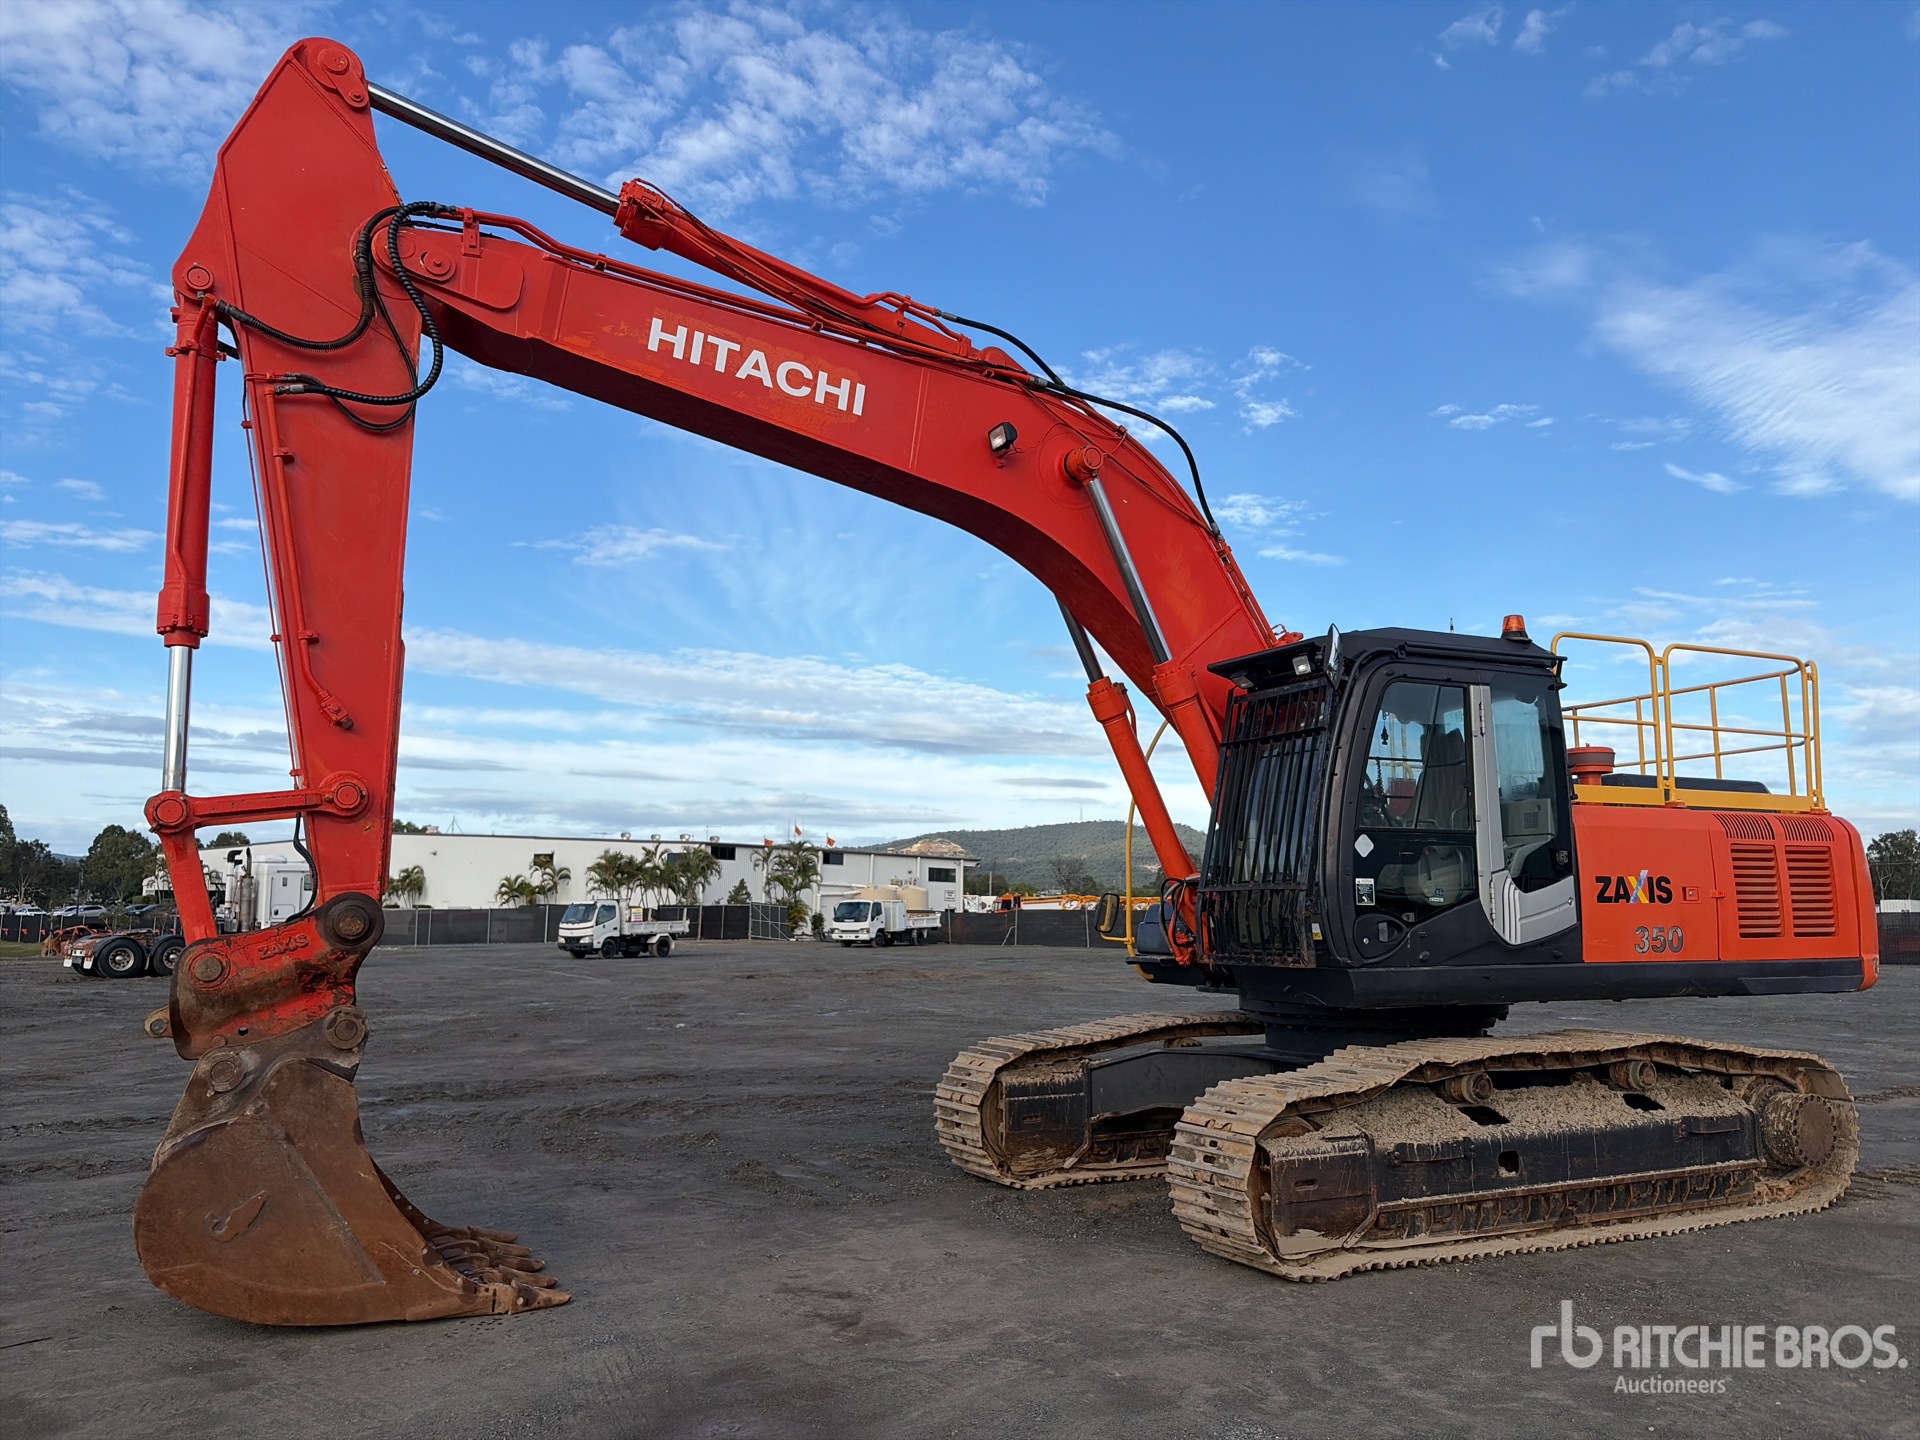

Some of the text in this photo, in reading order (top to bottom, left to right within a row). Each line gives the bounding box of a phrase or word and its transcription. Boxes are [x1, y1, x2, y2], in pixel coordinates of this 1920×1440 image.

[647, 317, 866, 416] HITACHI
[1595, 869, 1673, 904] ZAXIS
[1634, 925, 1684, 954] 350
